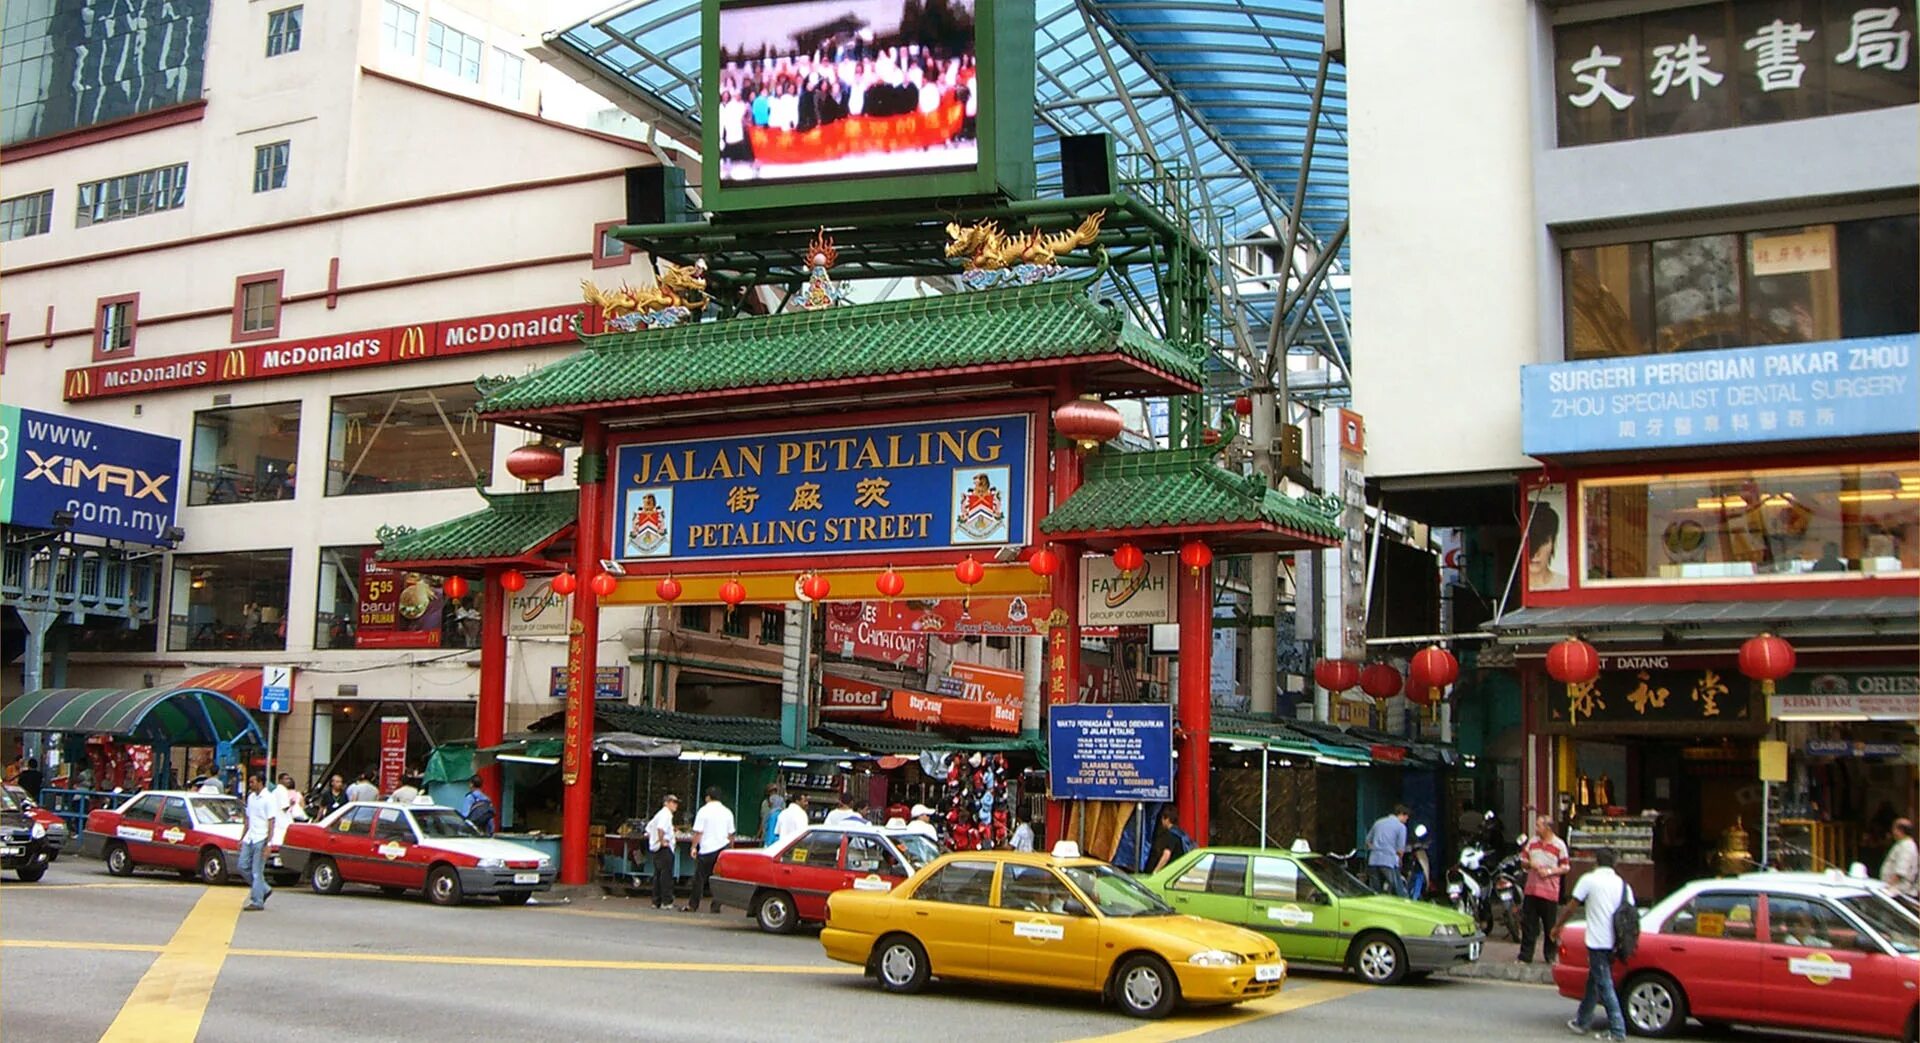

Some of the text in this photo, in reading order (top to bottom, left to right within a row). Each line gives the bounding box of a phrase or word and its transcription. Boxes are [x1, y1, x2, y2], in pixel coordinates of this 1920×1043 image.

[1569, 7, 1911, 110] 文殊書局
[104, 360, 207, 387] McDonald's
[263, 338, 381, 368] McDonald's
[446, 313, 579, 346] McDonald's
[1549, 345, 1909, 392] SURGERI PERGIGIAN PAKAR ZHOU
[1551, 375, 1907, 417] ZHOU SPECIALIST DENTAL SURGERY
[27, 420, 98, 450] www.
[633, 426, 1003, 484] JALAN PETALING
[66, 500, 168, 538] com.my
[688, 513, 933, 547] PETALING STREET
[1090, 609, 1165, 620] GROUP OF COMPANIES
[1617, 656, 1669, 669] DATANG
[832, 689, 877, 705] Hotel
[995, 705, 1015, 721] Hotel
